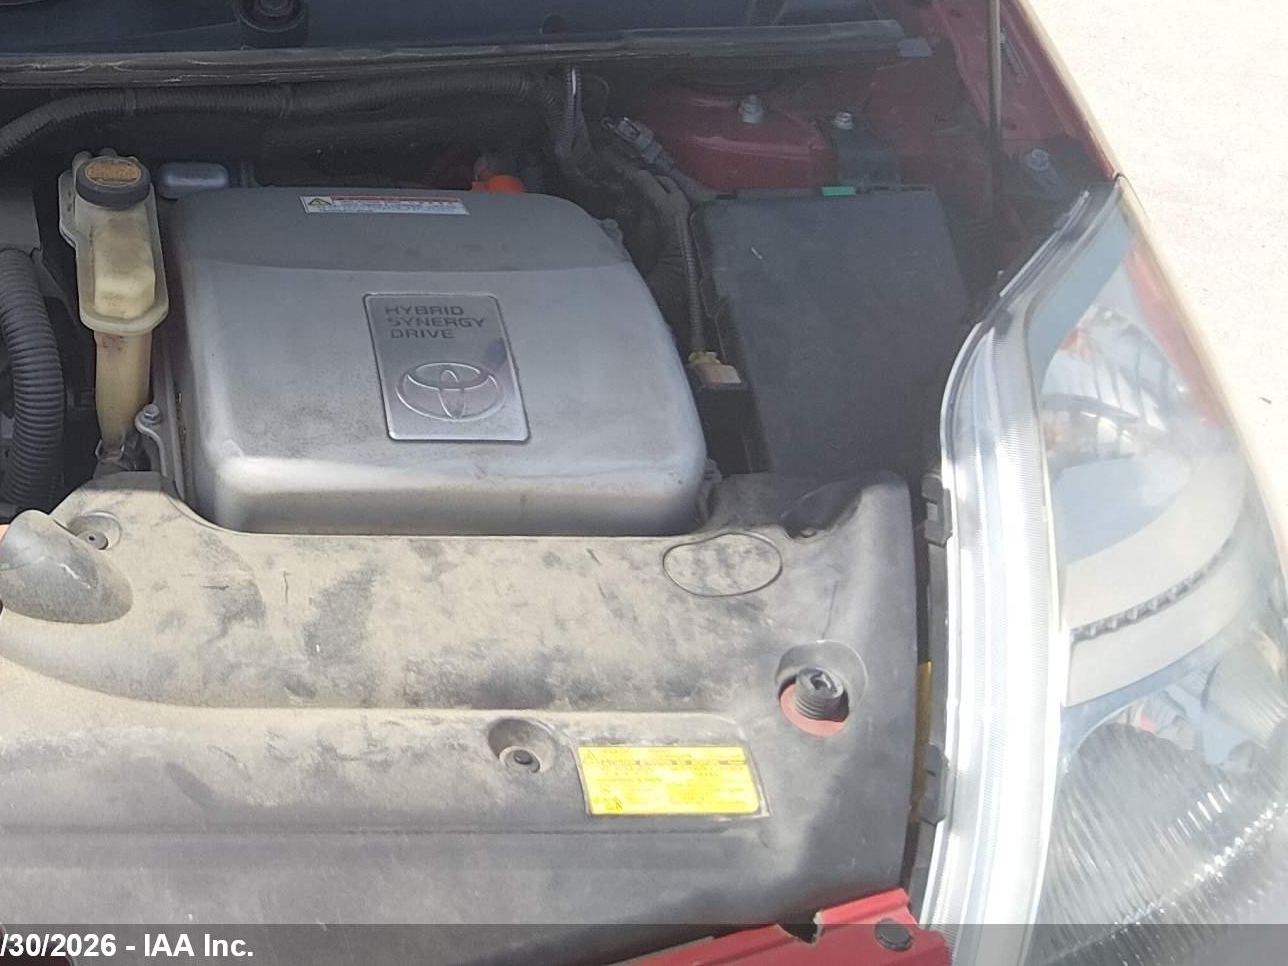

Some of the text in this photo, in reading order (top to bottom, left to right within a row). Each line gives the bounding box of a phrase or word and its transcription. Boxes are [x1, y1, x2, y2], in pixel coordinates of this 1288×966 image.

[385, 305, 465, 316] HYBRID
[387, 316, 487, 328] SYNERGY
[390, 328, 456, 339] DRIVE
